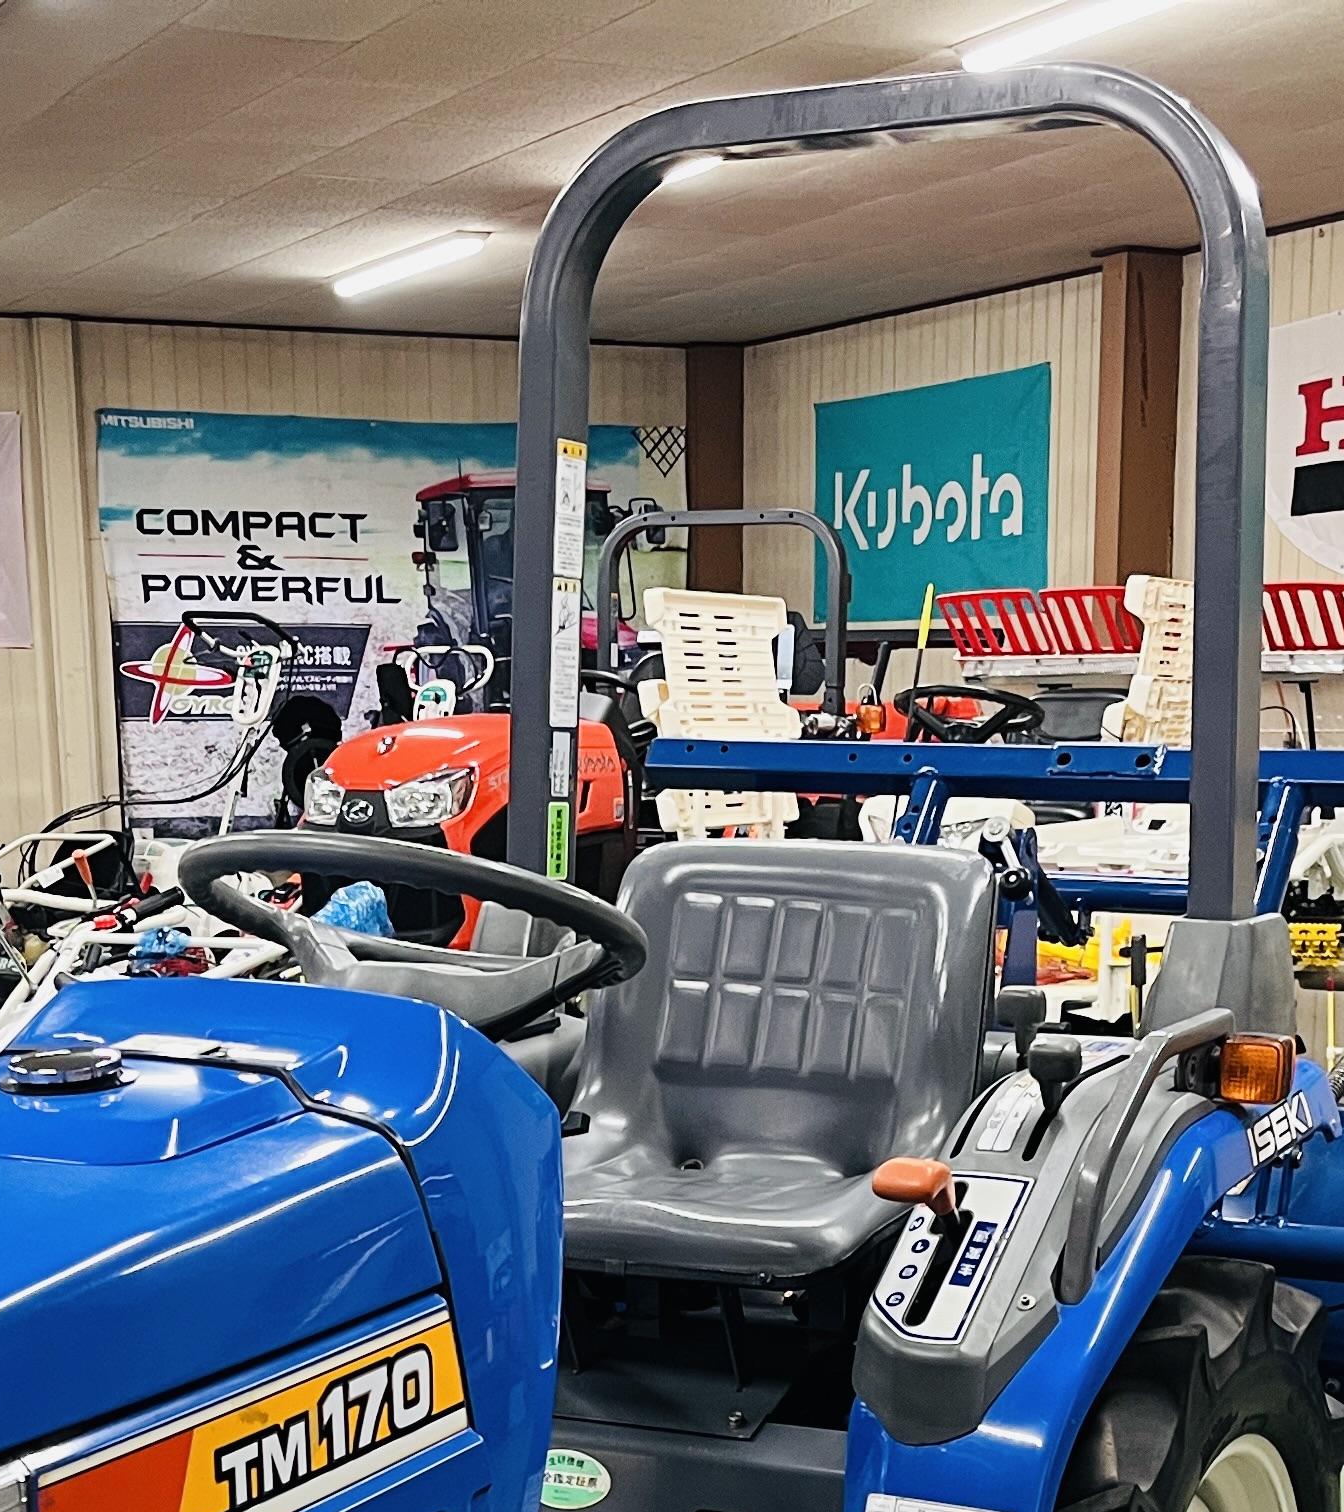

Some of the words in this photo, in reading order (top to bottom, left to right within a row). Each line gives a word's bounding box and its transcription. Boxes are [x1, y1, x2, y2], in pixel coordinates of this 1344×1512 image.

[100, 414, 195, 430] MITSUBISHI
[834, 453, 1023, 551] Kubota
[135, 508, 368, 544] COMPACT
[236, 544, 286, 571] &
[141, 574, 402, 606] POWERFUL
[1246, 1091, 1314, 1168] ISEKI
